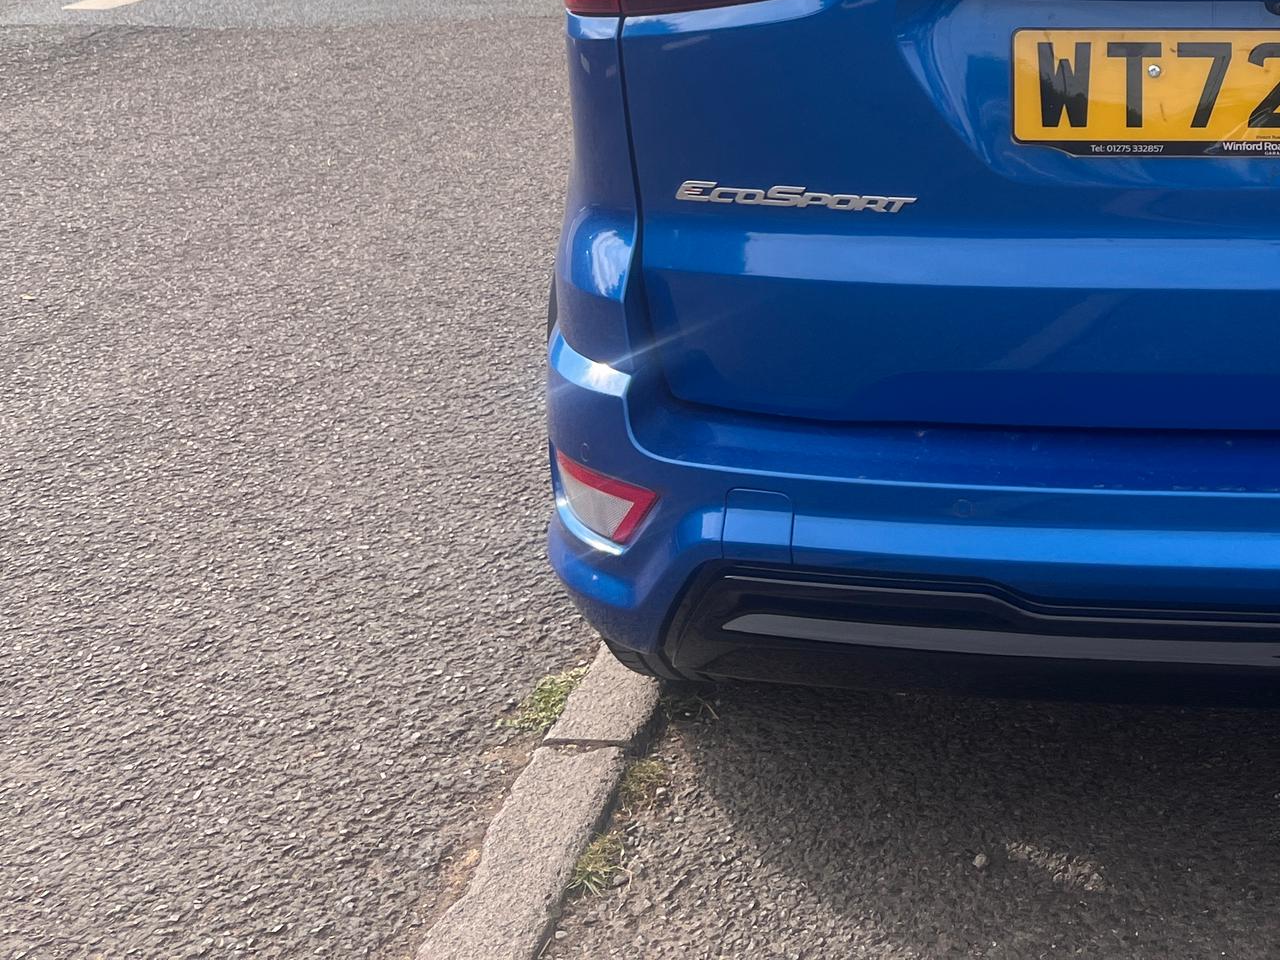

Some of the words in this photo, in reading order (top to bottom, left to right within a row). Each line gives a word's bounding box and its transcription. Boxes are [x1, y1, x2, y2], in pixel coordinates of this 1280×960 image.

[1090, 144, 1105, 153] Tel:
[1106, 144, 1131, 153] 01275
[1132, 144, 1164, 153] 332857
[1222, 141, 1263, 151] Winford
